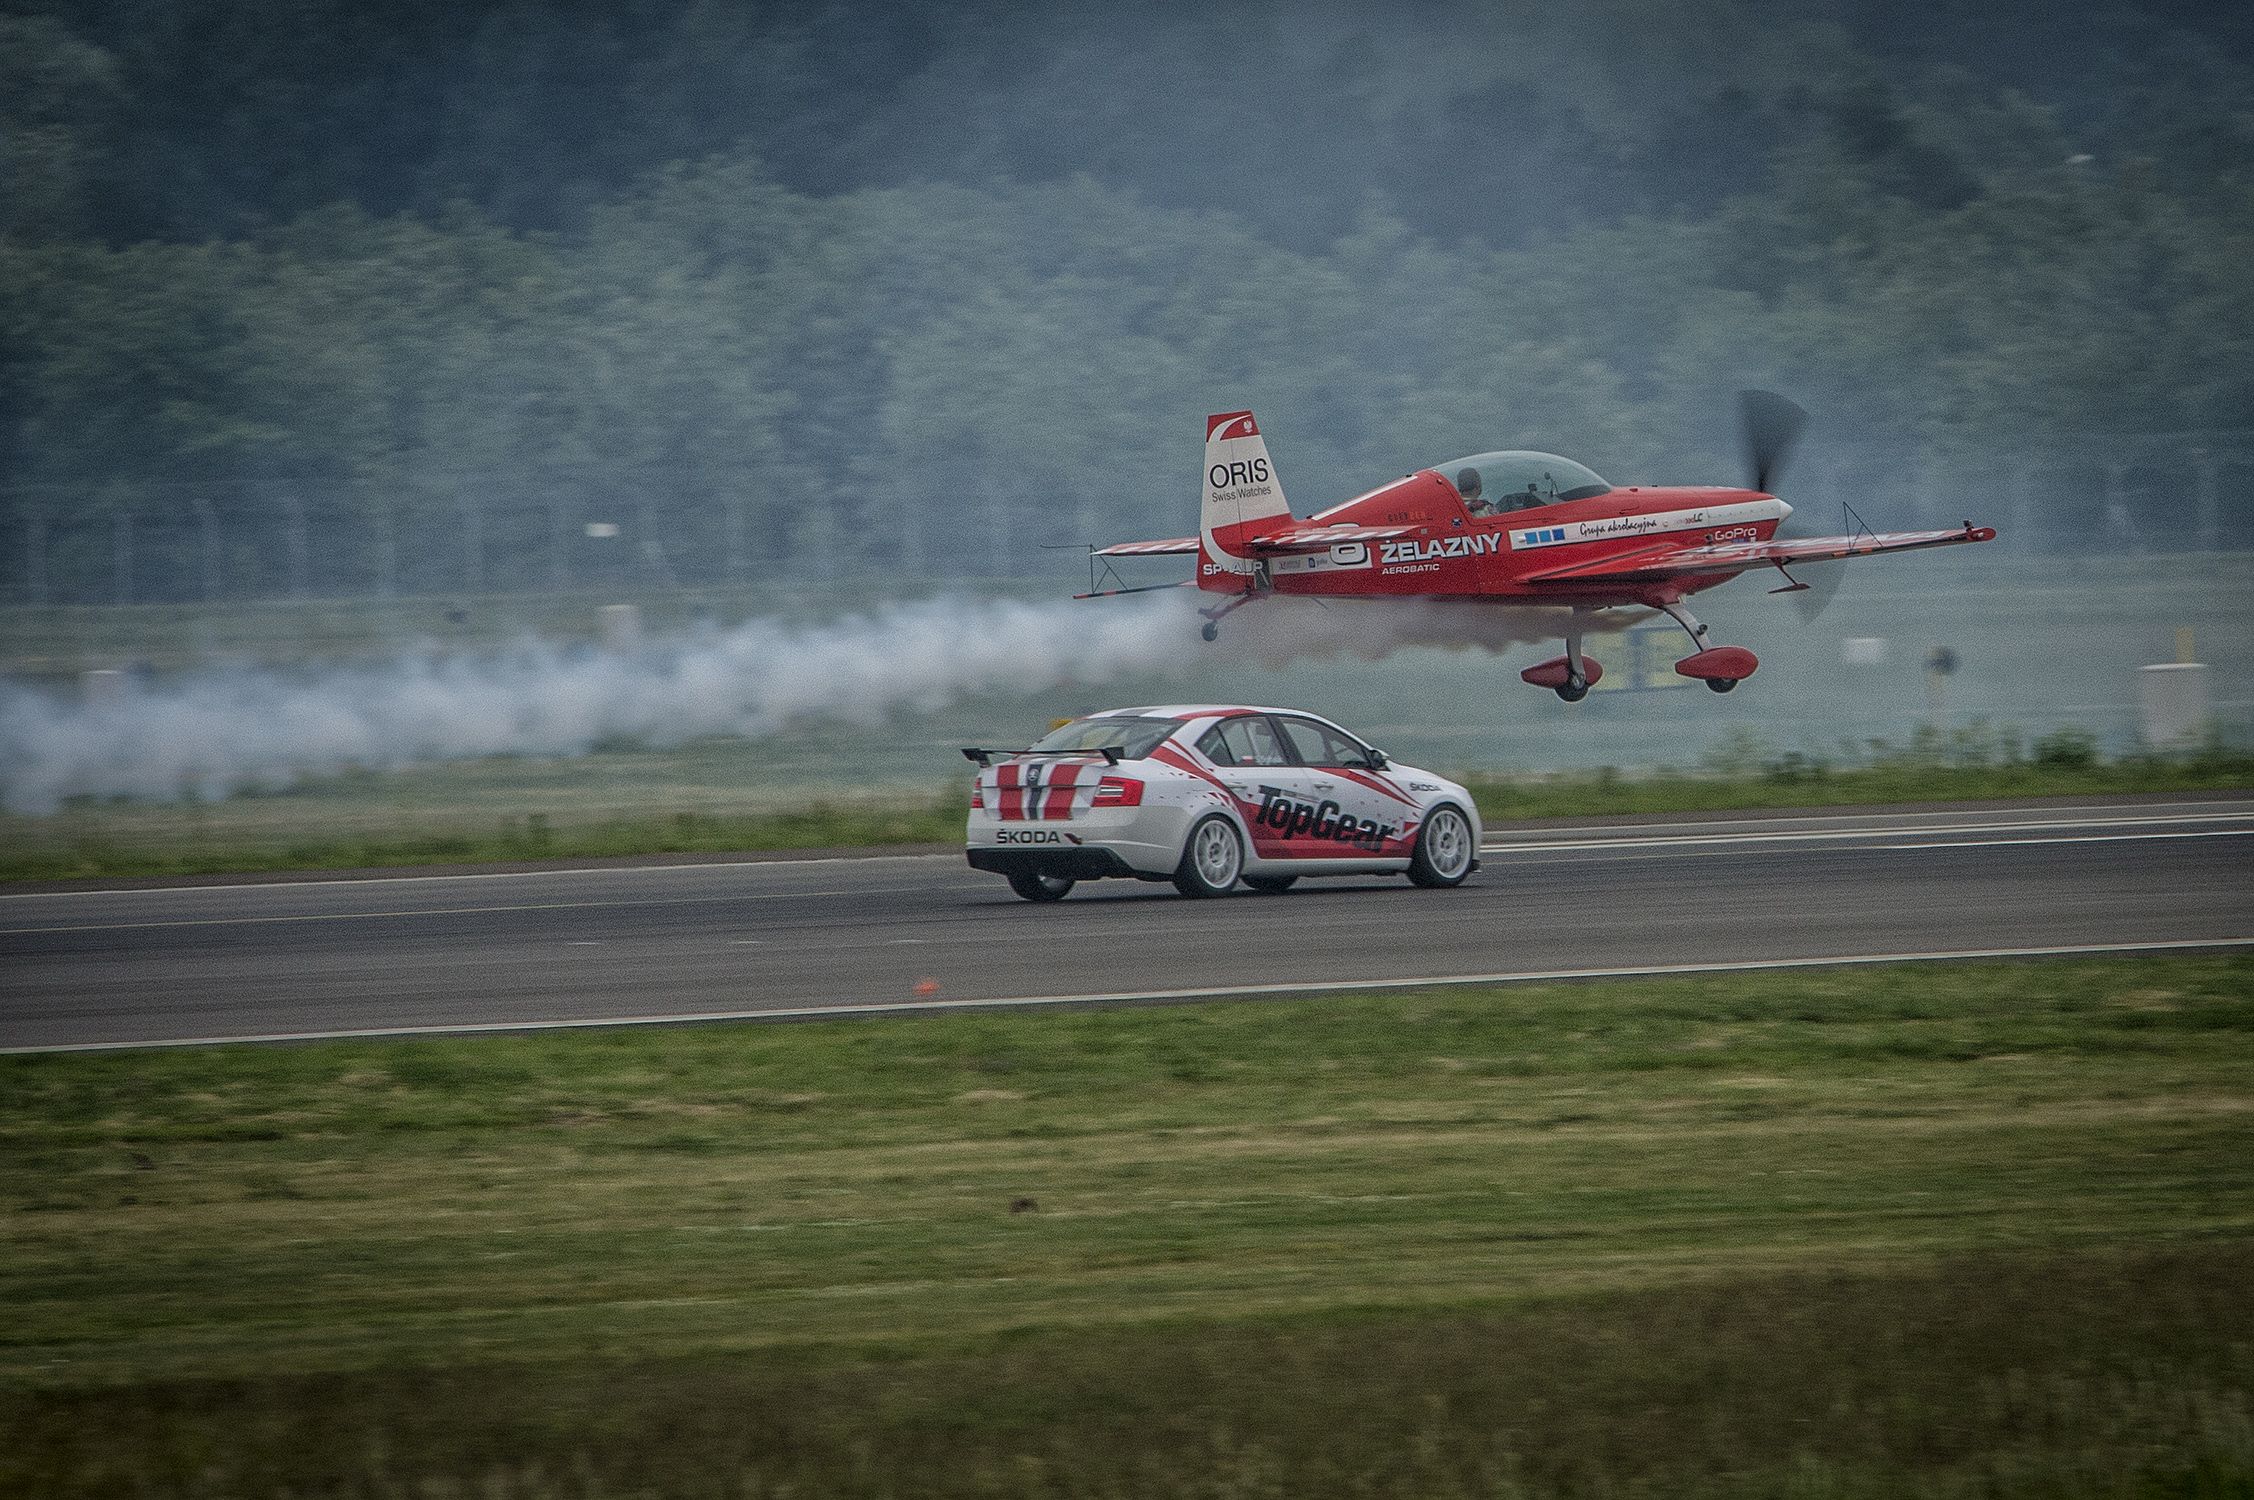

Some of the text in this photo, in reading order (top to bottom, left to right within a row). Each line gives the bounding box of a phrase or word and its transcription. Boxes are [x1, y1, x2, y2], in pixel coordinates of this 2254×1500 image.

[1209, 458, 1269, 489] ORIS
[1212, 485, 1272, 503] Swiss Watches
[1579, 522, 1605, 537] Grupa
[1714, 527, 1757, 540] GoPro
[1380, 532, 1502, 565] ŻELAZNY
[1381, 563, 1440, 575] AEROBATIC
[1255, 784, 1397, 853] TopGear
[996, 828, 1061, 844] ŠKODA
